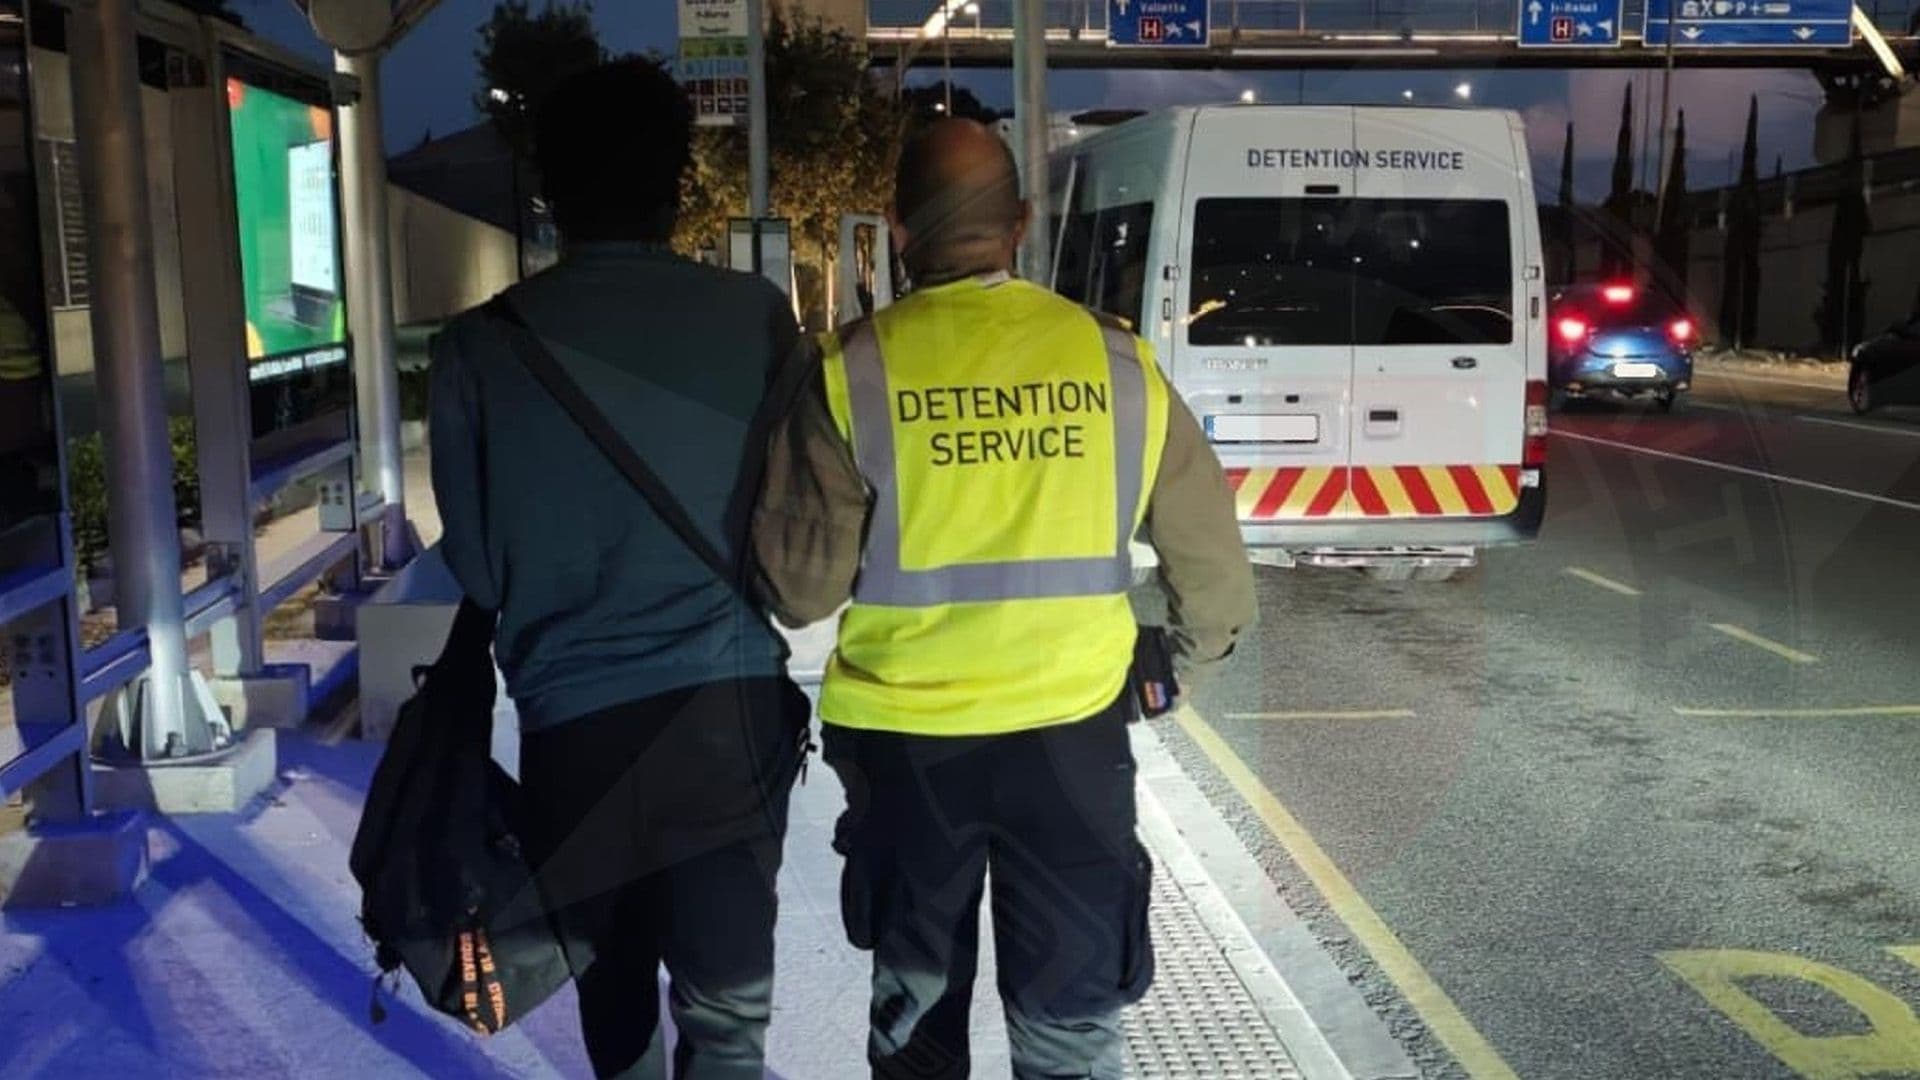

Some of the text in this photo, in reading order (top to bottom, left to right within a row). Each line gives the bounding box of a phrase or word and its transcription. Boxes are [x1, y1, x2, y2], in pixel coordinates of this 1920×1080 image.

[1248, 149, 1464, 170] DETENTION SERVICE
[897, 381, 1107, 422] DETENTION
[930, 425, 1085, 466] SERVICE
